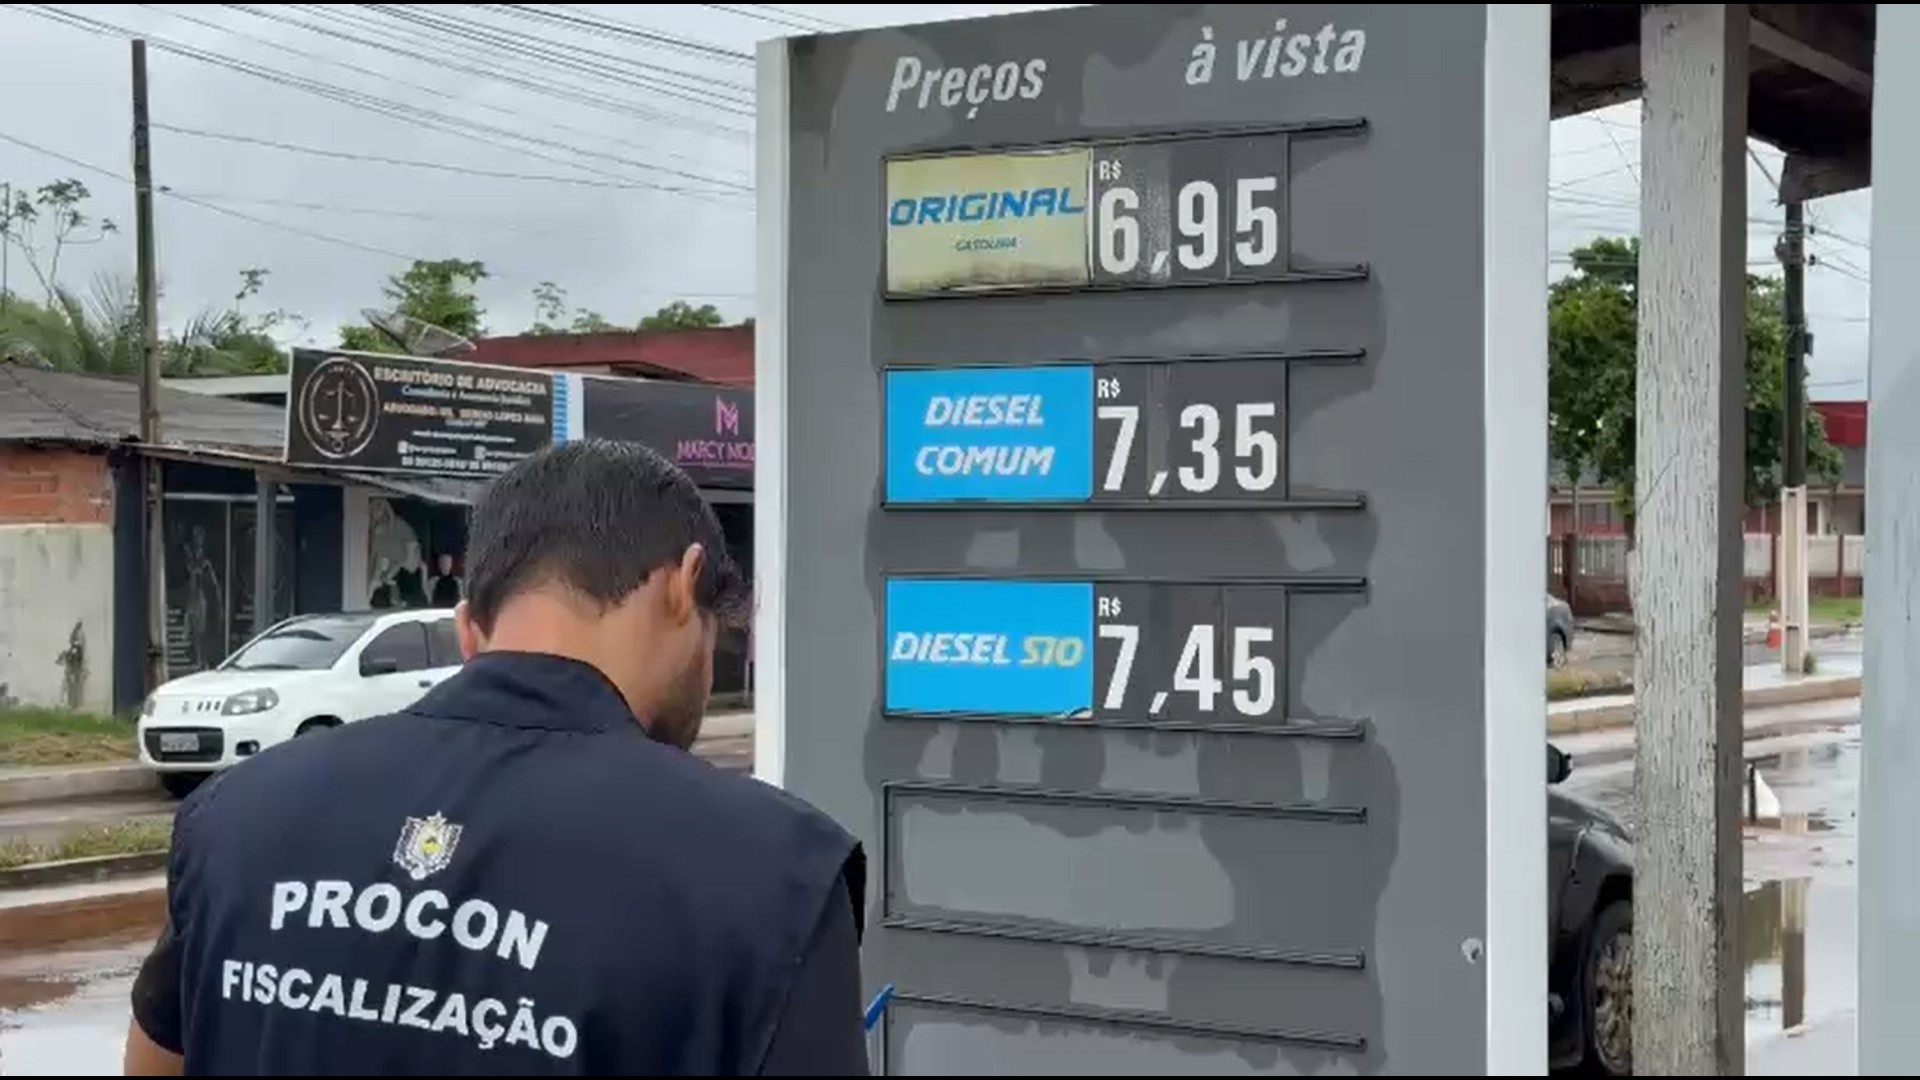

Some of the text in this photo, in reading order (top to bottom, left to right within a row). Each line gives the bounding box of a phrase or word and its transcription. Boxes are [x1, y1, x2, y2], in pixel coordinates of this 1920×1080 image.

[1185, 18, 1366, 86] à vista
[885, 56, 1047, 119] Preços
[1098, 160, 1122, 181] R$
[888, 187, 1086, 227] ORIGINAL
[1098, 177, 1279, 275] 6,95
[456, 374, 474, 389] DE
[476, 377, 547, 395] ADVOCACIA
[1097, 377, 1121, 399] R$
[924, 393, 1044, 427] DIESEL
[677, 439, 725, 460] MARCY
[914, 445, 1056, 476] COMUM
[1097, 402, 1279, 496] 7,35
[1098, 596, 1122, 618] R$
[891, 631, 1085, 667] DIESEL S10
[1098, 624, 1275, 716] 7,45
[270, 880, 549, 970] PROCON
[222, 959, 578, 1058] FISCALIZAÇÃO
